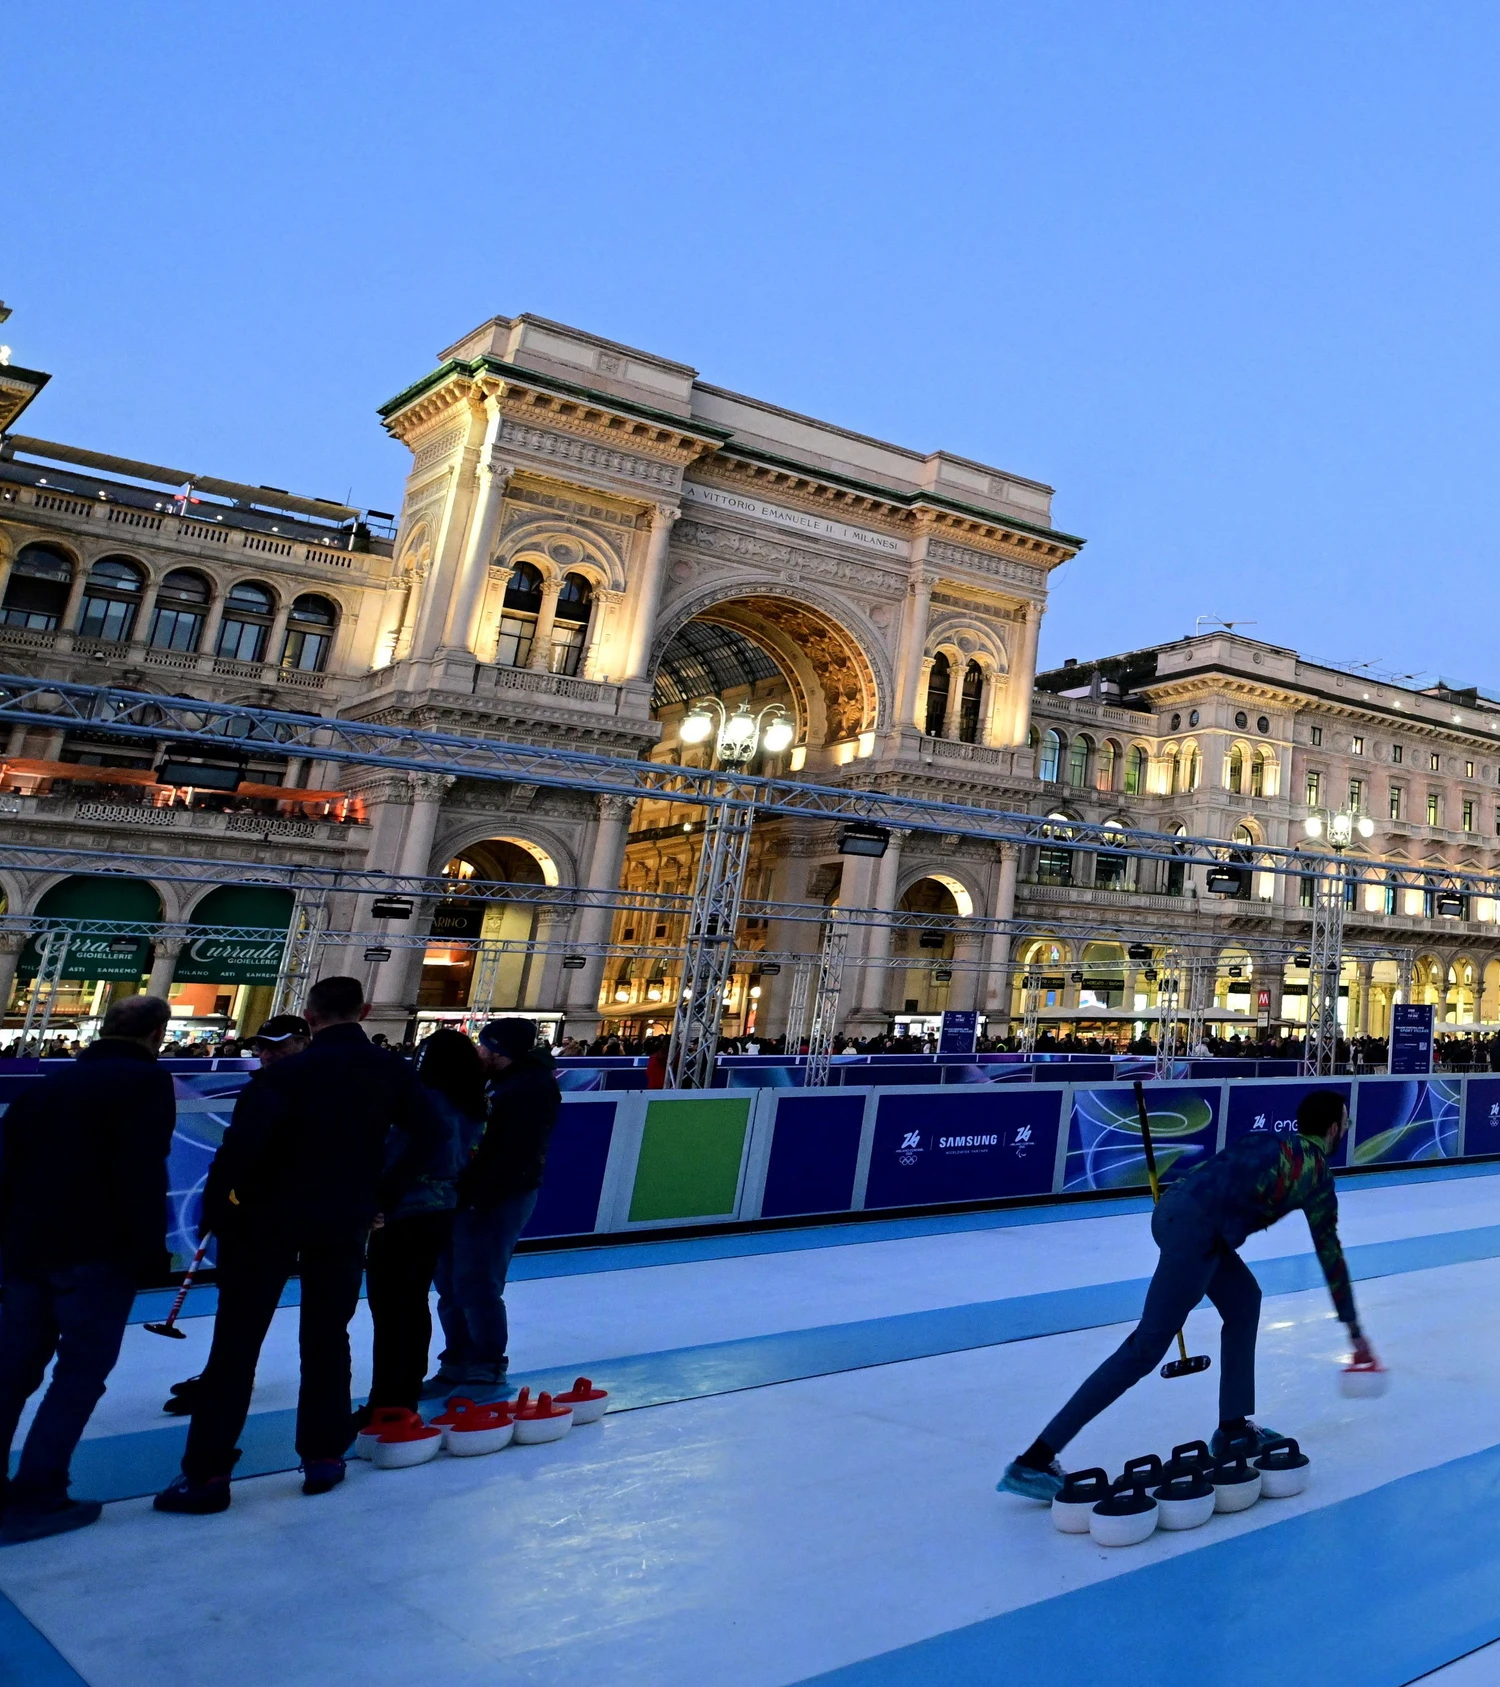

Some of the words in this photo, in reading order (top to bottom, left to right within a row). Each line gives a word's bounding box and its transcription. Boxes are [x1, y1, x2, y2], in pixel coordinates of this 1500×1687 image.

[687, 486, 696, 496] A
[703, 490, 756, 512] VITTORIO
[762, 507, 821, 530] EMANUELE
[852, 531, 898, 550] MILANESI
[190, 934, 281, 962] Currado
[76, 952, 133, 960] GIOIELLERIE
[1259, 993, 1269, 1004] M
[1274, 1119, 1298, 1132] ene
[939, 1134, 998, 1148] SAMSUNG
